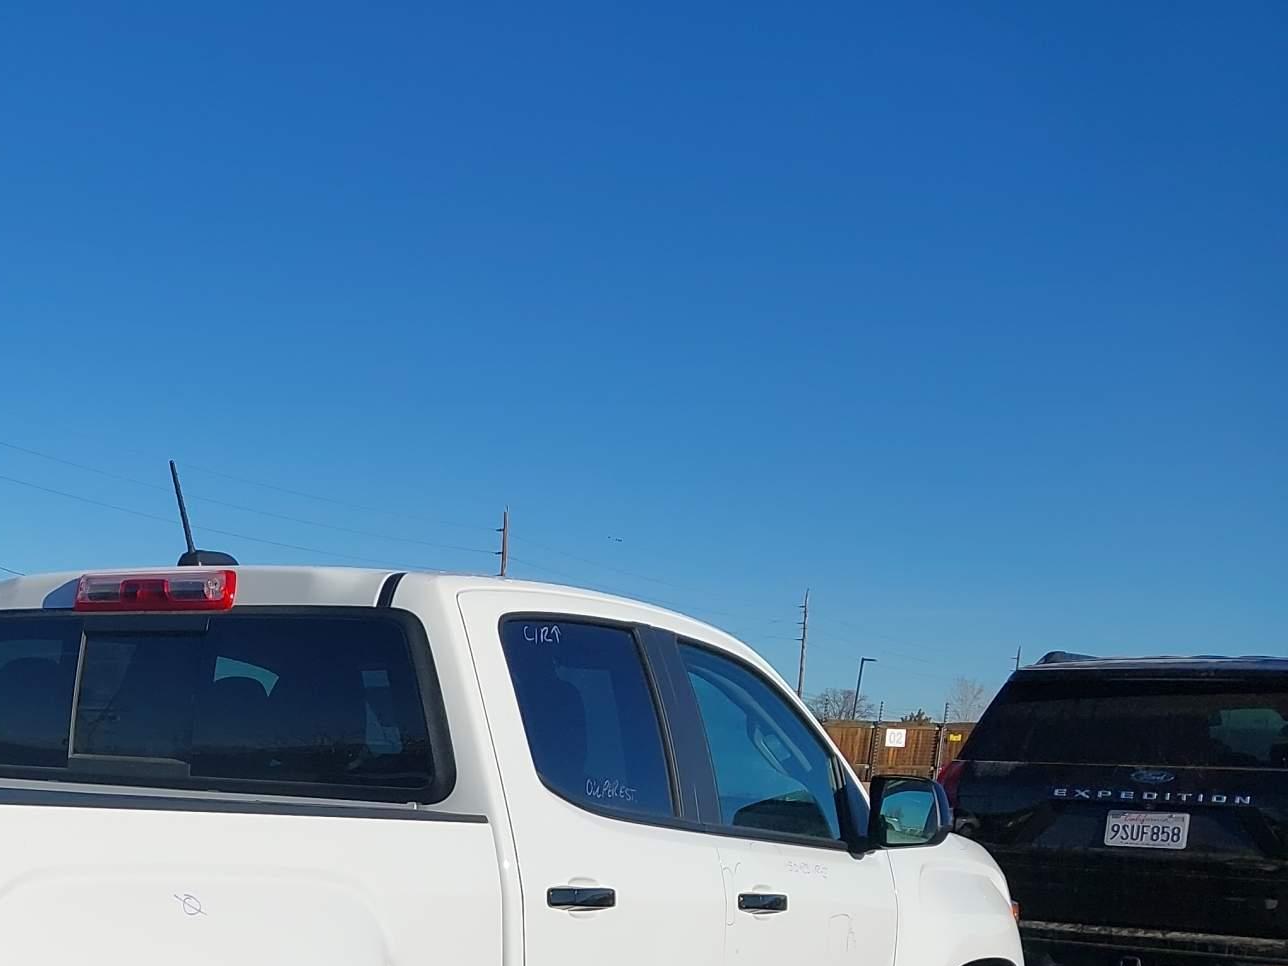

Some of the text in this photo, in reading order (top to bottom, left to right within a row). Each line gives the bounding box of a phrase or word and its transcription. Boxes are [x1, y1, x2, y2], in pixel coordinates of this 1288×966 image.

[889, 731, 903, 745] 02
[1053, 788, 1251, 805] EXPEDITION
[1109, 823, 1181, 843] 9SUF858
